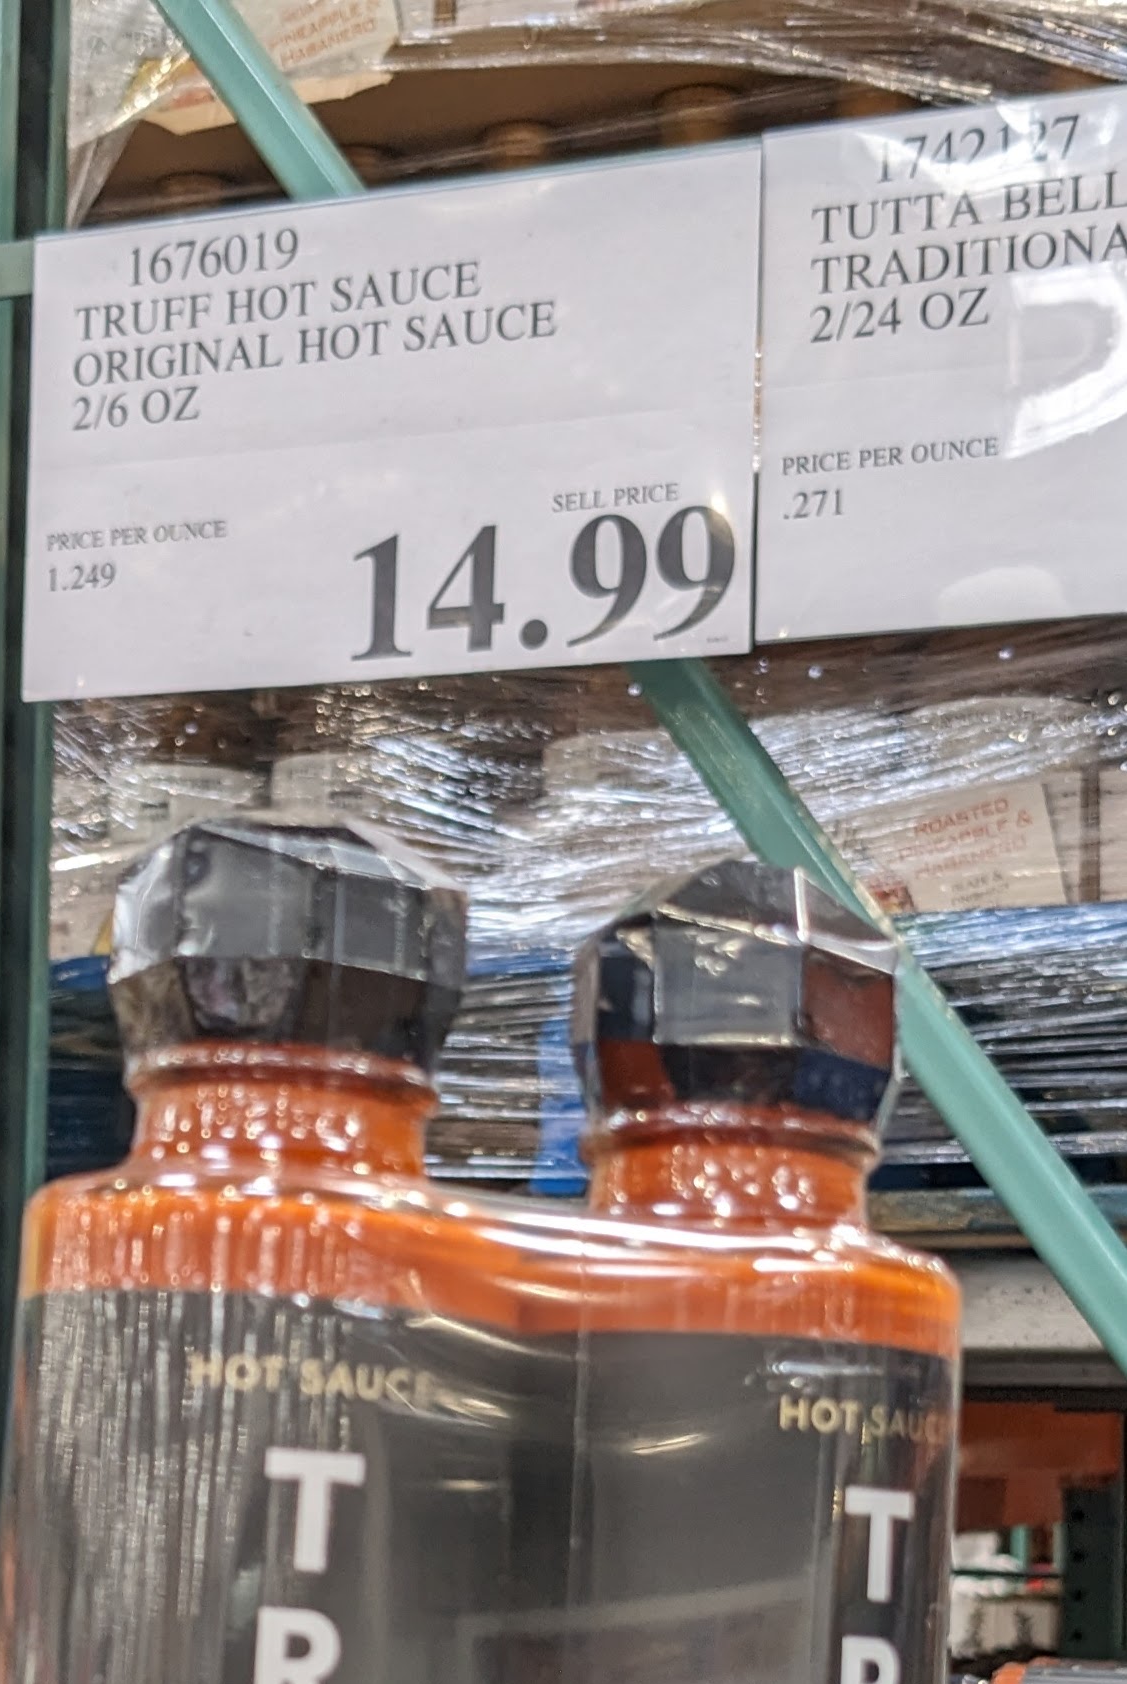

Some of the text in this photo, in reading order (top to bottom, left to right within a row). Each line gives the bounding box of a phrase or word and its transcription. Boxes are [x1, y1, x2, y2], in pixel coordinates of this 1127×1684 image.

[878, 114, 1079, 183] 1742127
[811, 170, 1127, 246] TUTTA BELL
[128, 227, 299, 287] 1676019
[810, 223, 1127, 295] TRADITIONA
[76, 260, 483, 341] TRUFF HOT SAUCE
[810, 286, 991, 344] 2/24 OZ
[73, 300, 557, 388] ORIGINAL HOT SAUCE
[73, 385, 201, 431] 2/6 OZ
[782, 436, 1000, 477] PRICE PER OUNCE
[552, 481, 680, 514] SELL PRICE
[783, 489, 845, 521] .271
[47, 518, 230, 552] PRICE PER OUNCE
[48, 562, 117, 592] 1.249
[351, 504, 737, 663] 14.99
[914, 796, 1010, 835] ROASTED
[190, 1352, 439, 1404] HOT SAUCE
[779, 1394, 860, 1434] HOT
